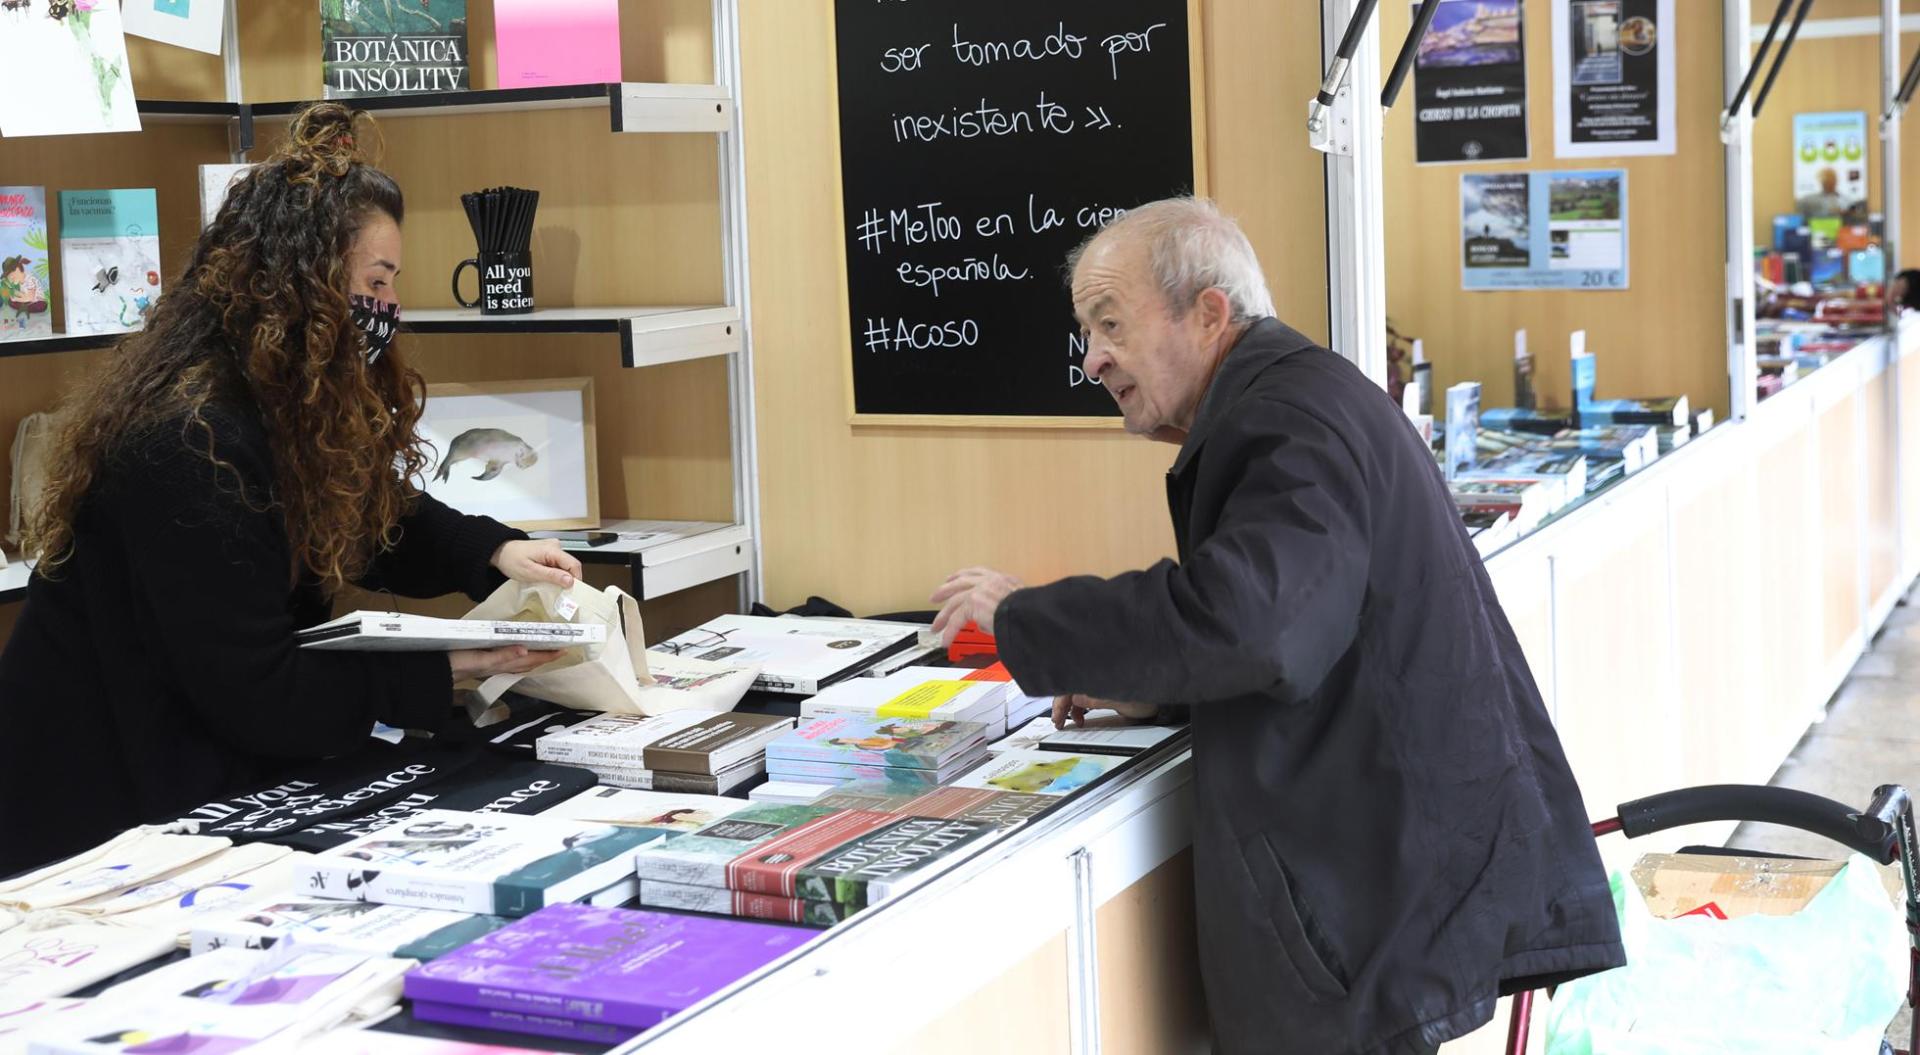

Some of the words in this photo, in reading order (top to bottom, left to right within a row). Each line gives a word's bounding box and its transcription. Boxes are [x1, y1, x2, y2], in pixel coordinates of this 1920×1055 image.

[333, 33, 462, 63] BOTÁNICA
[880, 43, 931, 72] ser
[952, 21, 1087, 66] tomado
[1100, 23, 1166, 80] por
[892, 91, 1074, 142] inexistente
[856, 202, 961, 254] #MeToo
[976, 213, 1014, 237] en
[1028, 193, 1065, 233] la
[1077, 203, 1127, 229] cien
[485, 264, 505, 279] All
[507, 267, 531, 283] you
[486, 279, 522, 294] need
[897, 253, 1034, 297] española.
[487, 295, 498, 309] is
[1069, 332, 1085, 357] N
[609, 751, 618, 760] POR
[616, 773, 625, 782] POR
[229, 780, 319, 809] you
[243, 817, 297, 832] is
[292, 764, 436, 817] science
[816, 819, 945, 873] BOTÁNICA
